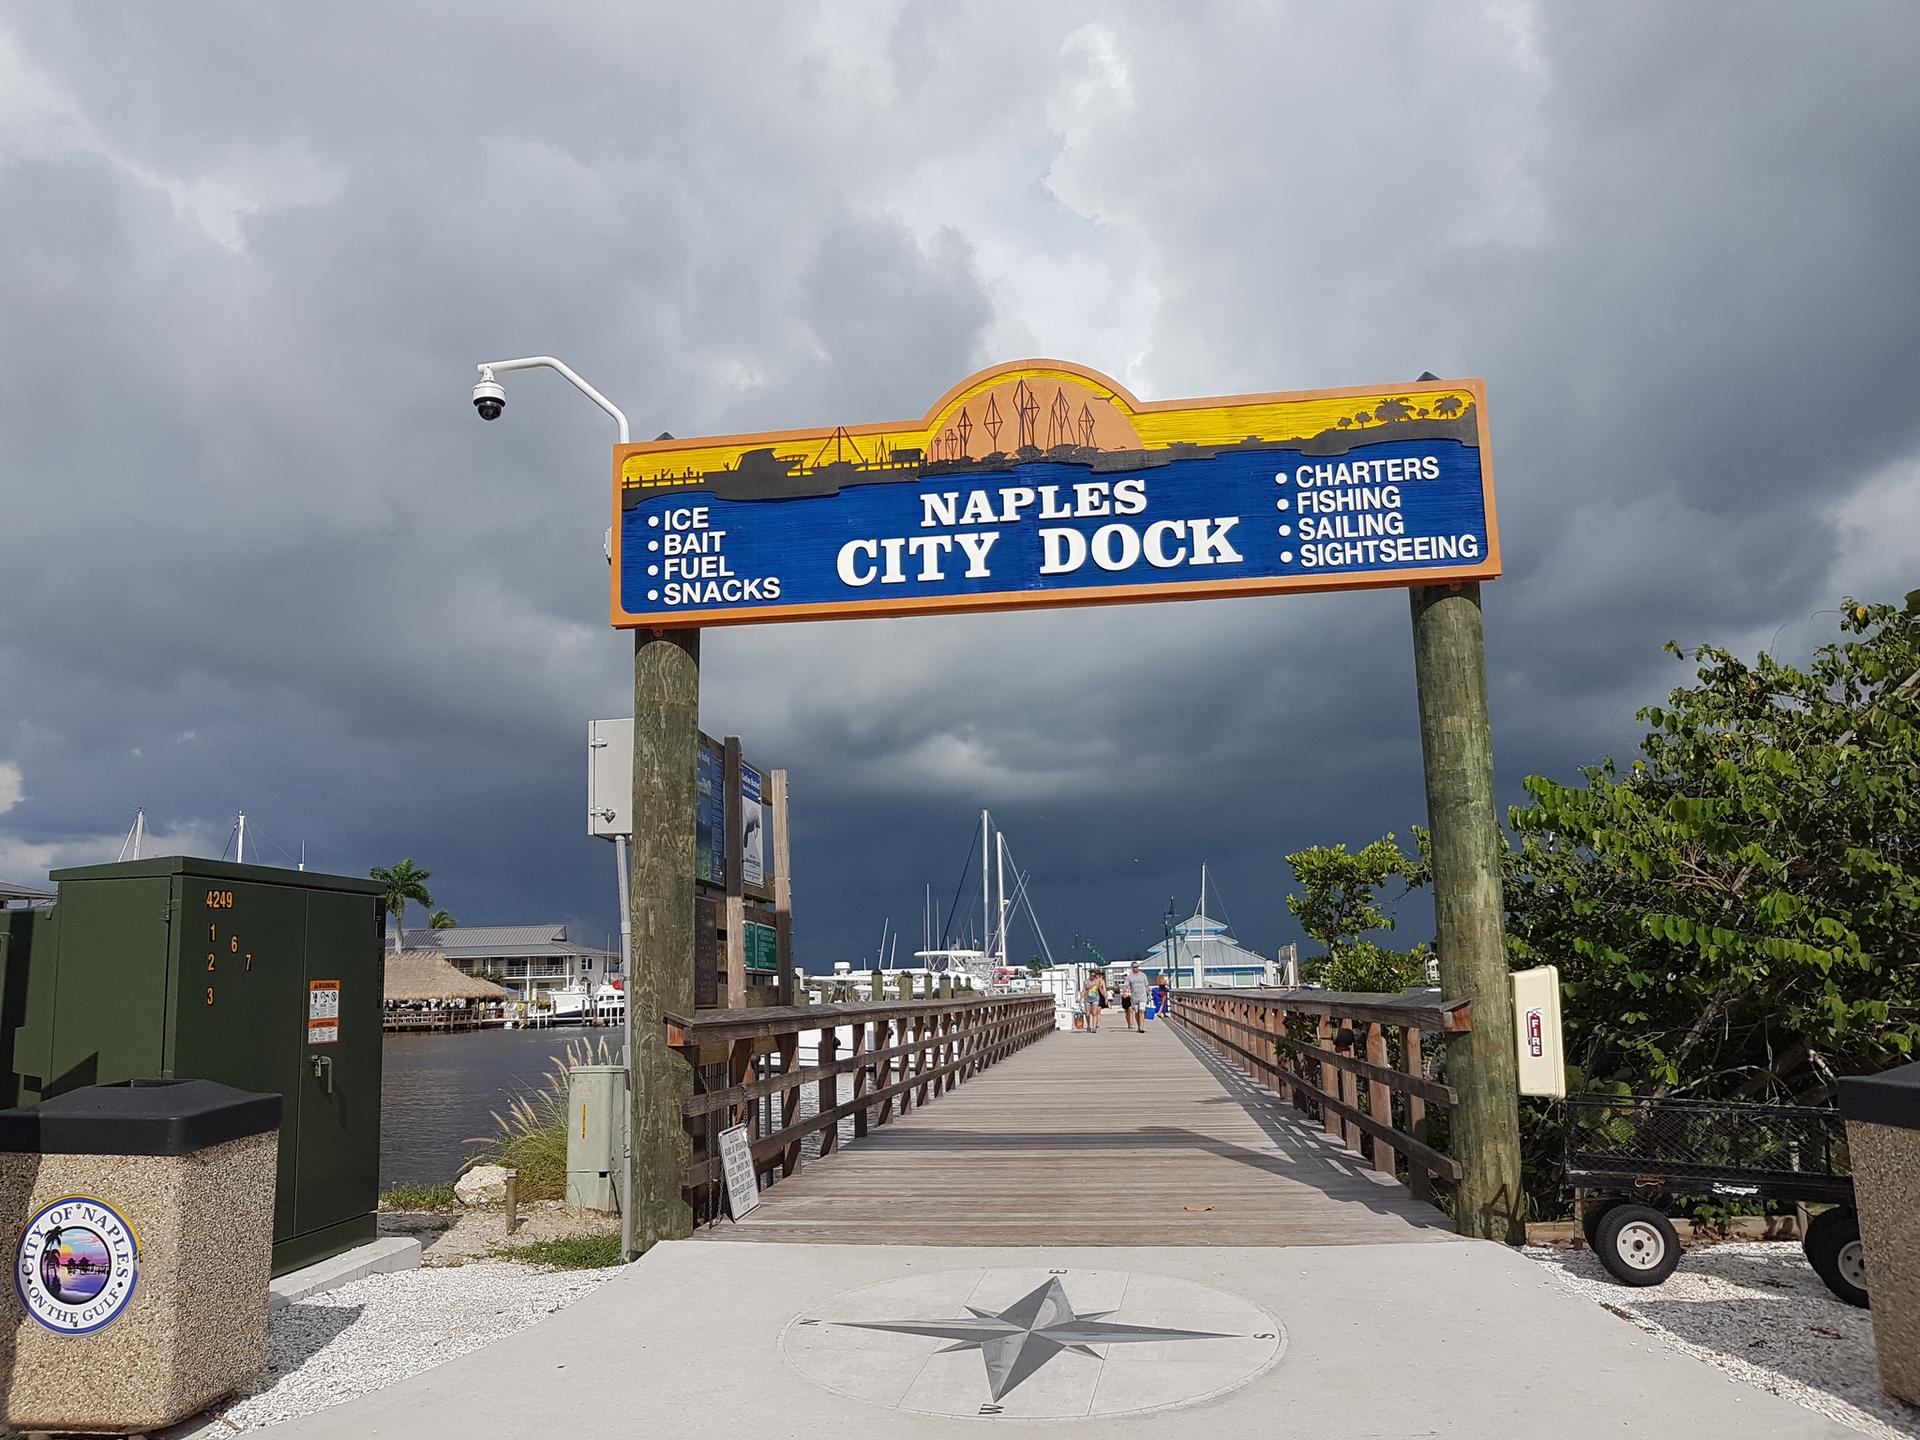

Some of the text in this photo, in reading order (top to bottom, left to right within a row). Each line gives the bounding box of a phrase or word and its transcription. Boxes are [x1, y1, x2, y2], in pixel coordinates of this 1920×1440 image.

[1295, 456, 1440, 488] CHARTERS
[920, 479, 1147, 527] NAPLES
[1297, 486, 1401, 515] FISHING
[664, 507, 709, 531] ICE
[1298, 511, 1404, 541] SAILING
[664, 531, 726, 556] BAIT
[836, 516, 1244, 586] CITY DOCK
[1300, 533, 1479, 568] SIGHTSEEING
[664, 556, 735, 580] FUEL
[663, 577, 781, 605] SNACKS
[207, 891, 233, 908] 4249
[210, 923, 216, 941] 1
[231, 936, 238, 953] 6
[207, 953, 216, 971] 2
[245, 954, 252, 971] 7
[207, 987, 214, 1005] 3
[1531, 1019, 1541, 1055] FIRE
[22, 1206, 130, 1279] CITY OF NAPLES
[28, 1286, 120, 1324] ON THE GULF
[798, 1318, 821, 1326] N
[978, 1403, 1004, 1415] W
